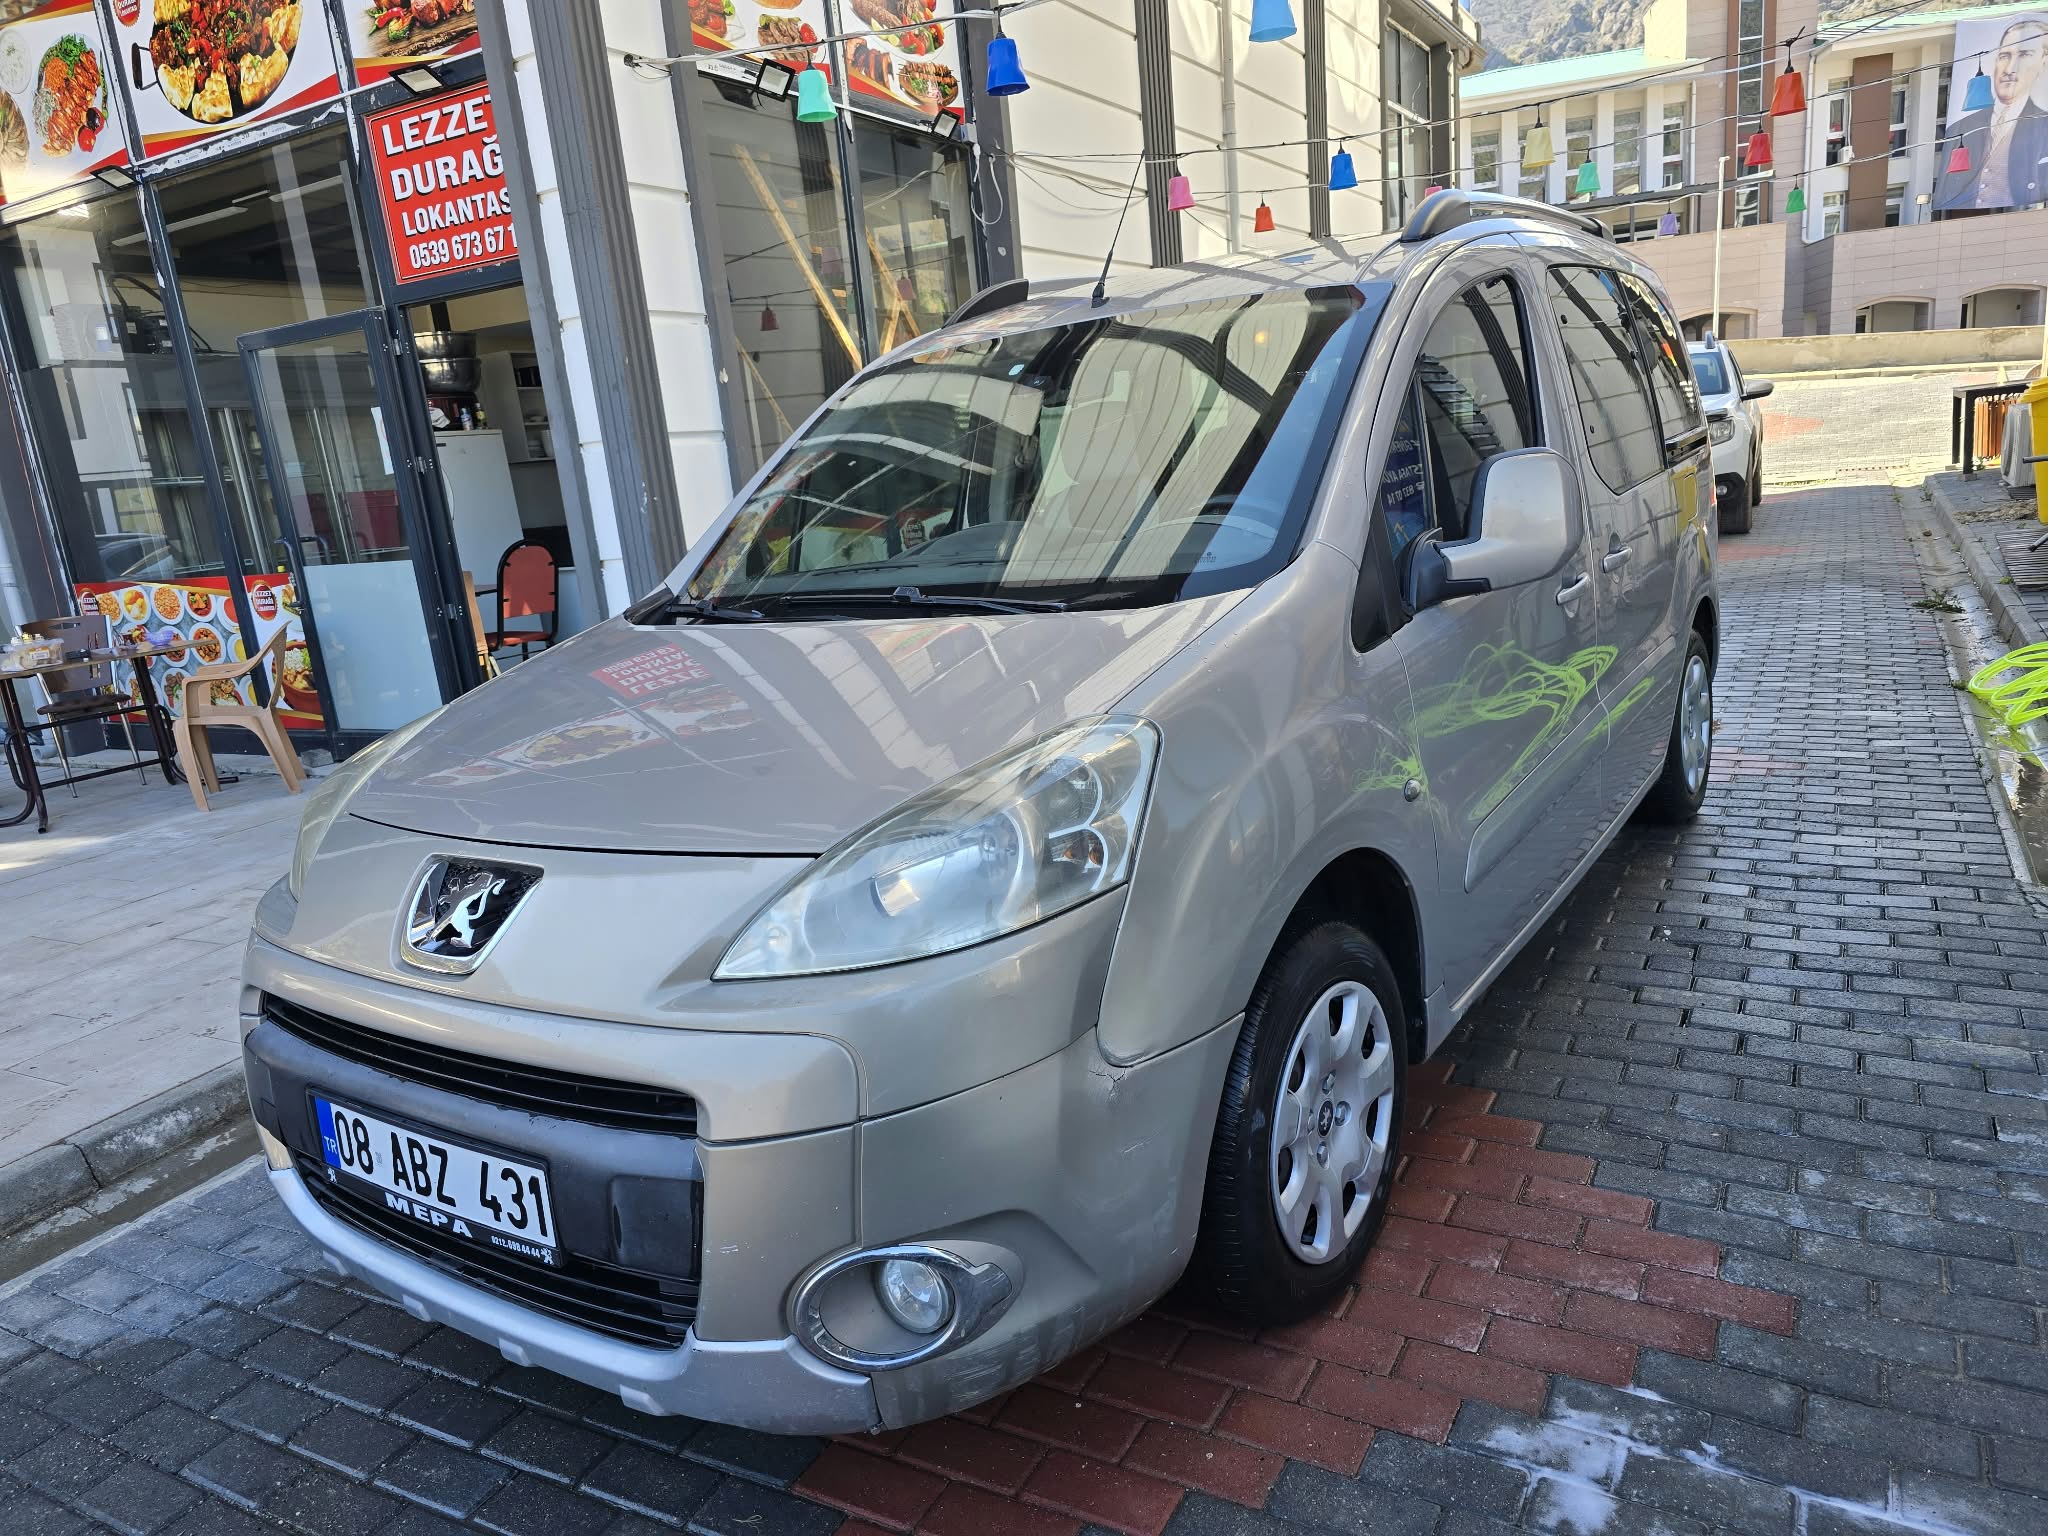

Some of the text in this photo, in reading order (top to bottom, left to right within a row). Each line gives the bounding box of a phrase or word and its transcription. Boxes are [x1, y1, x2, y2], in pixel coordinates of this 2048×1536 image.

[381, 95, 492, 156] LEZZE
[409, 239, 450, 269] 0539
[452, 231, 483, 260] 673
[484, 225, 505, 253] 67
[323, 1110, 549, 1238] TR 08 ABZ 431
[384, 1192, 473, 1238] MEPA
